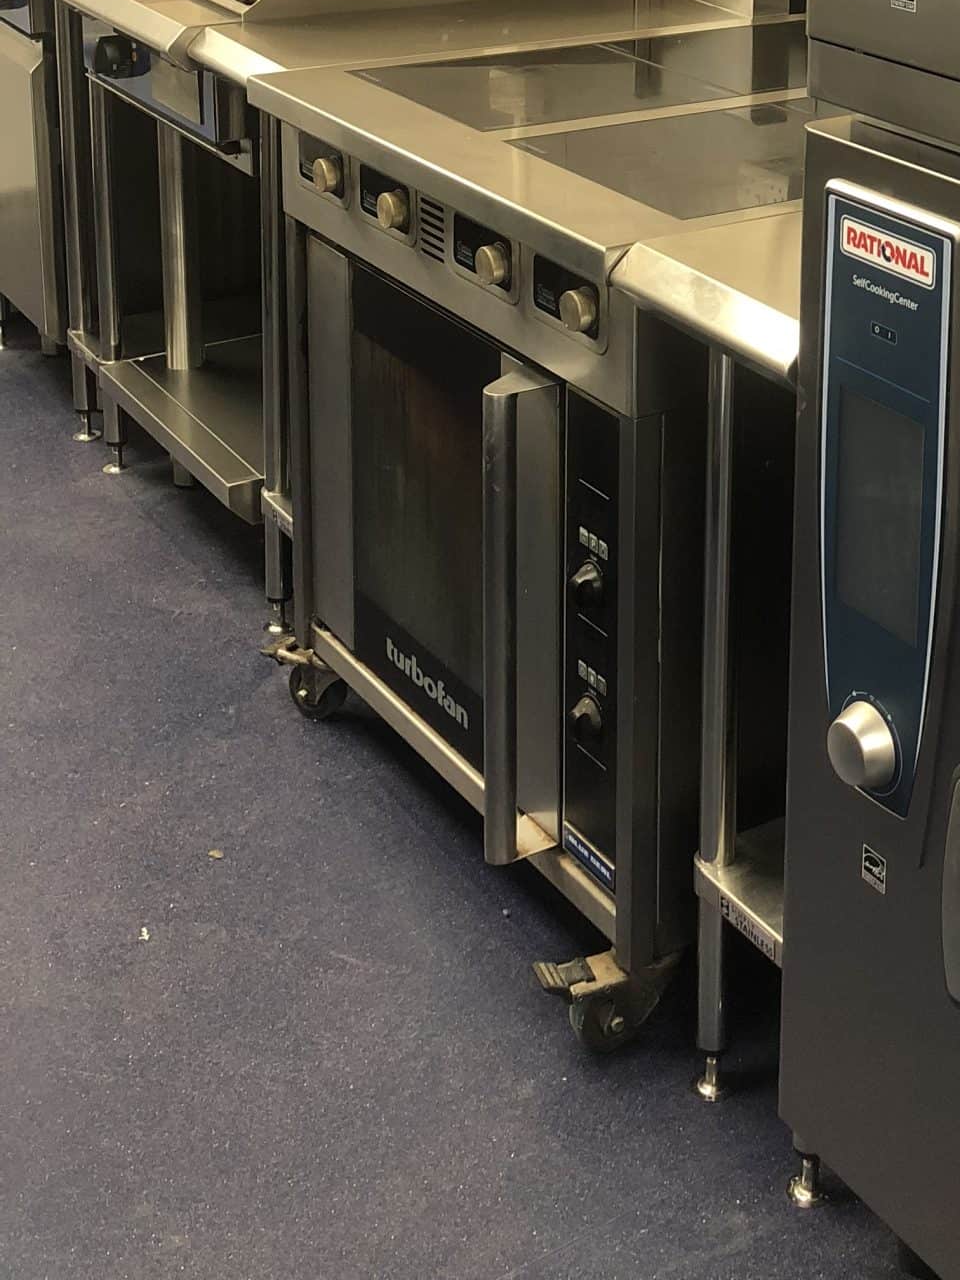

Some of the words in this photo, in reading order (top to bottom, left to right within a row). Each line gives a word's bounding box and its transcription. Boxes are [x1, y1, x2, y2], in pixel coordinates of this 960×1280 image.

[846, 226, 930, 278] RATIONAL
[852, 274, 919, 311] SelfCookingCenter
[386, 637, 469, 730] turbofan
